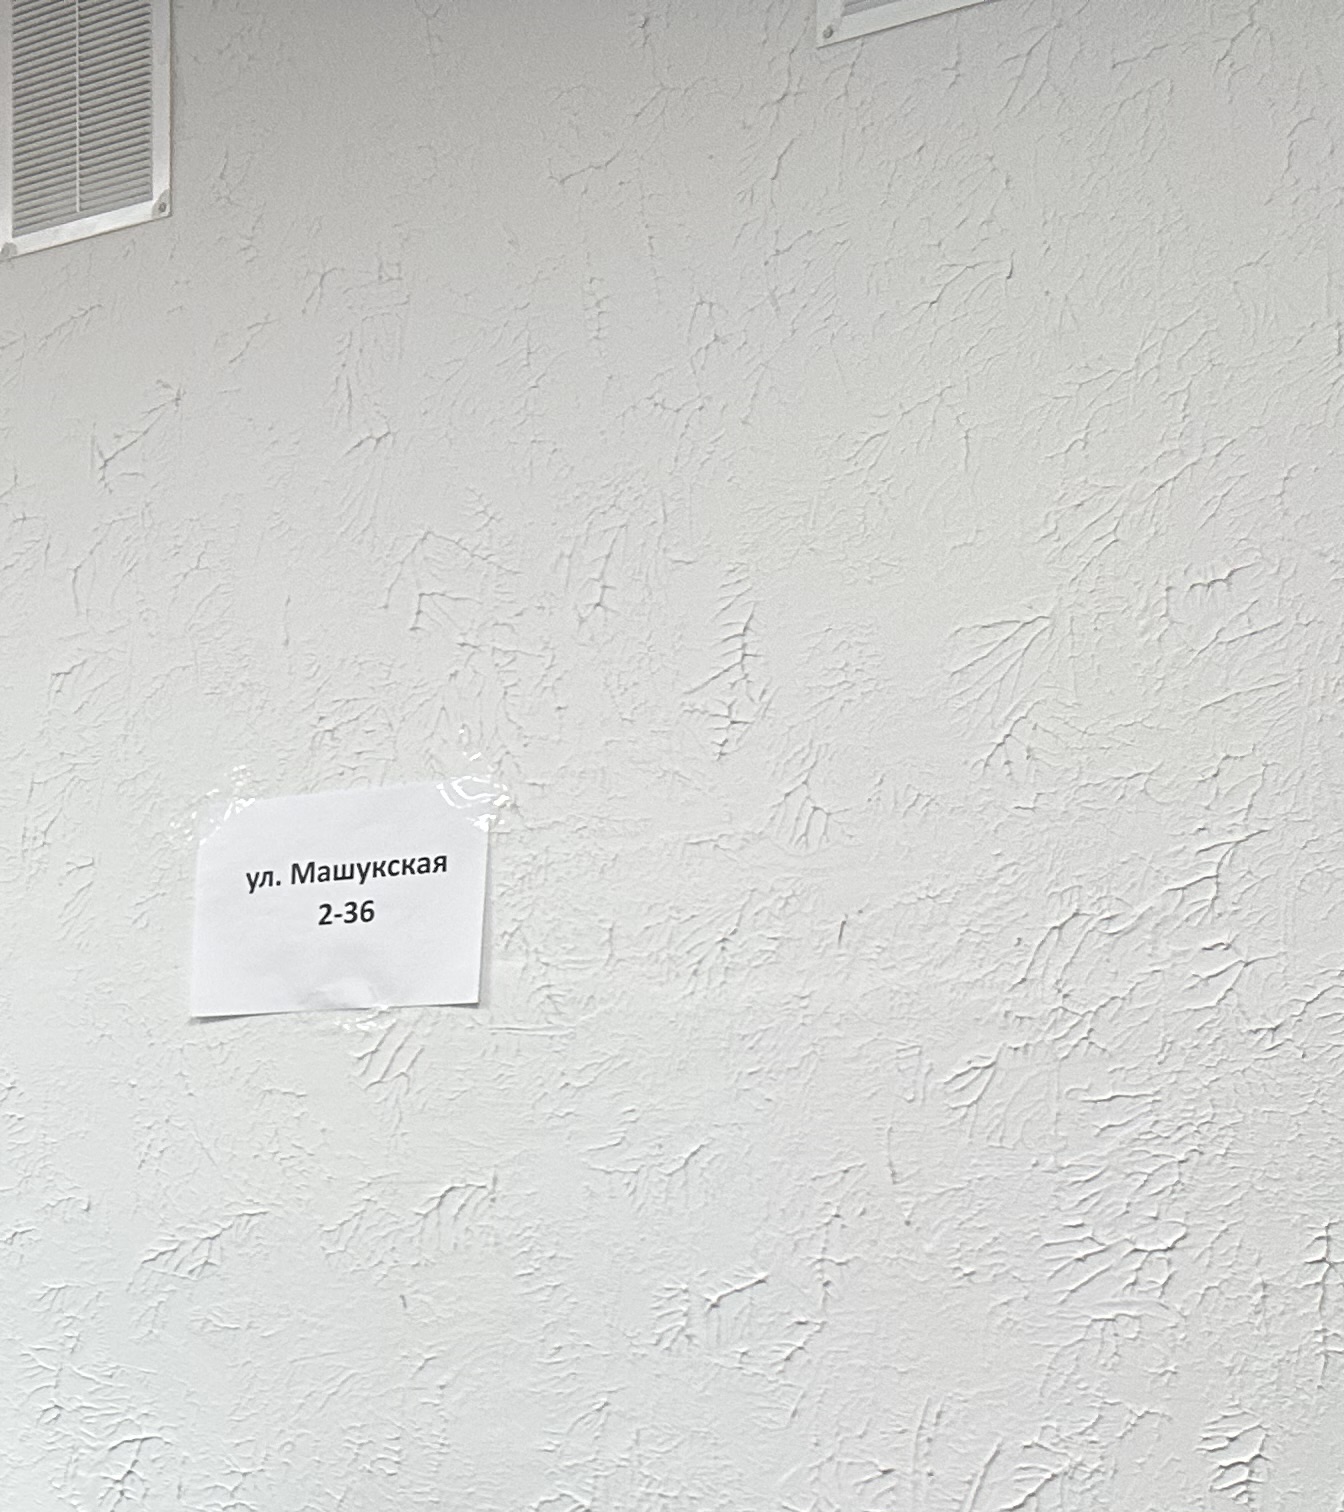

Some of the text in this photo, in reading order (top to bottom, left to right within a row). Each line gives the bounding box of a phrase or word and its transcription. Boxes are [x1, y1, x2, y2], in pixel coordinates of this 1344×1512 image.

[246, 855, 448, 894] ул. Машукская
[318, 900, 375, 925] 2-36
